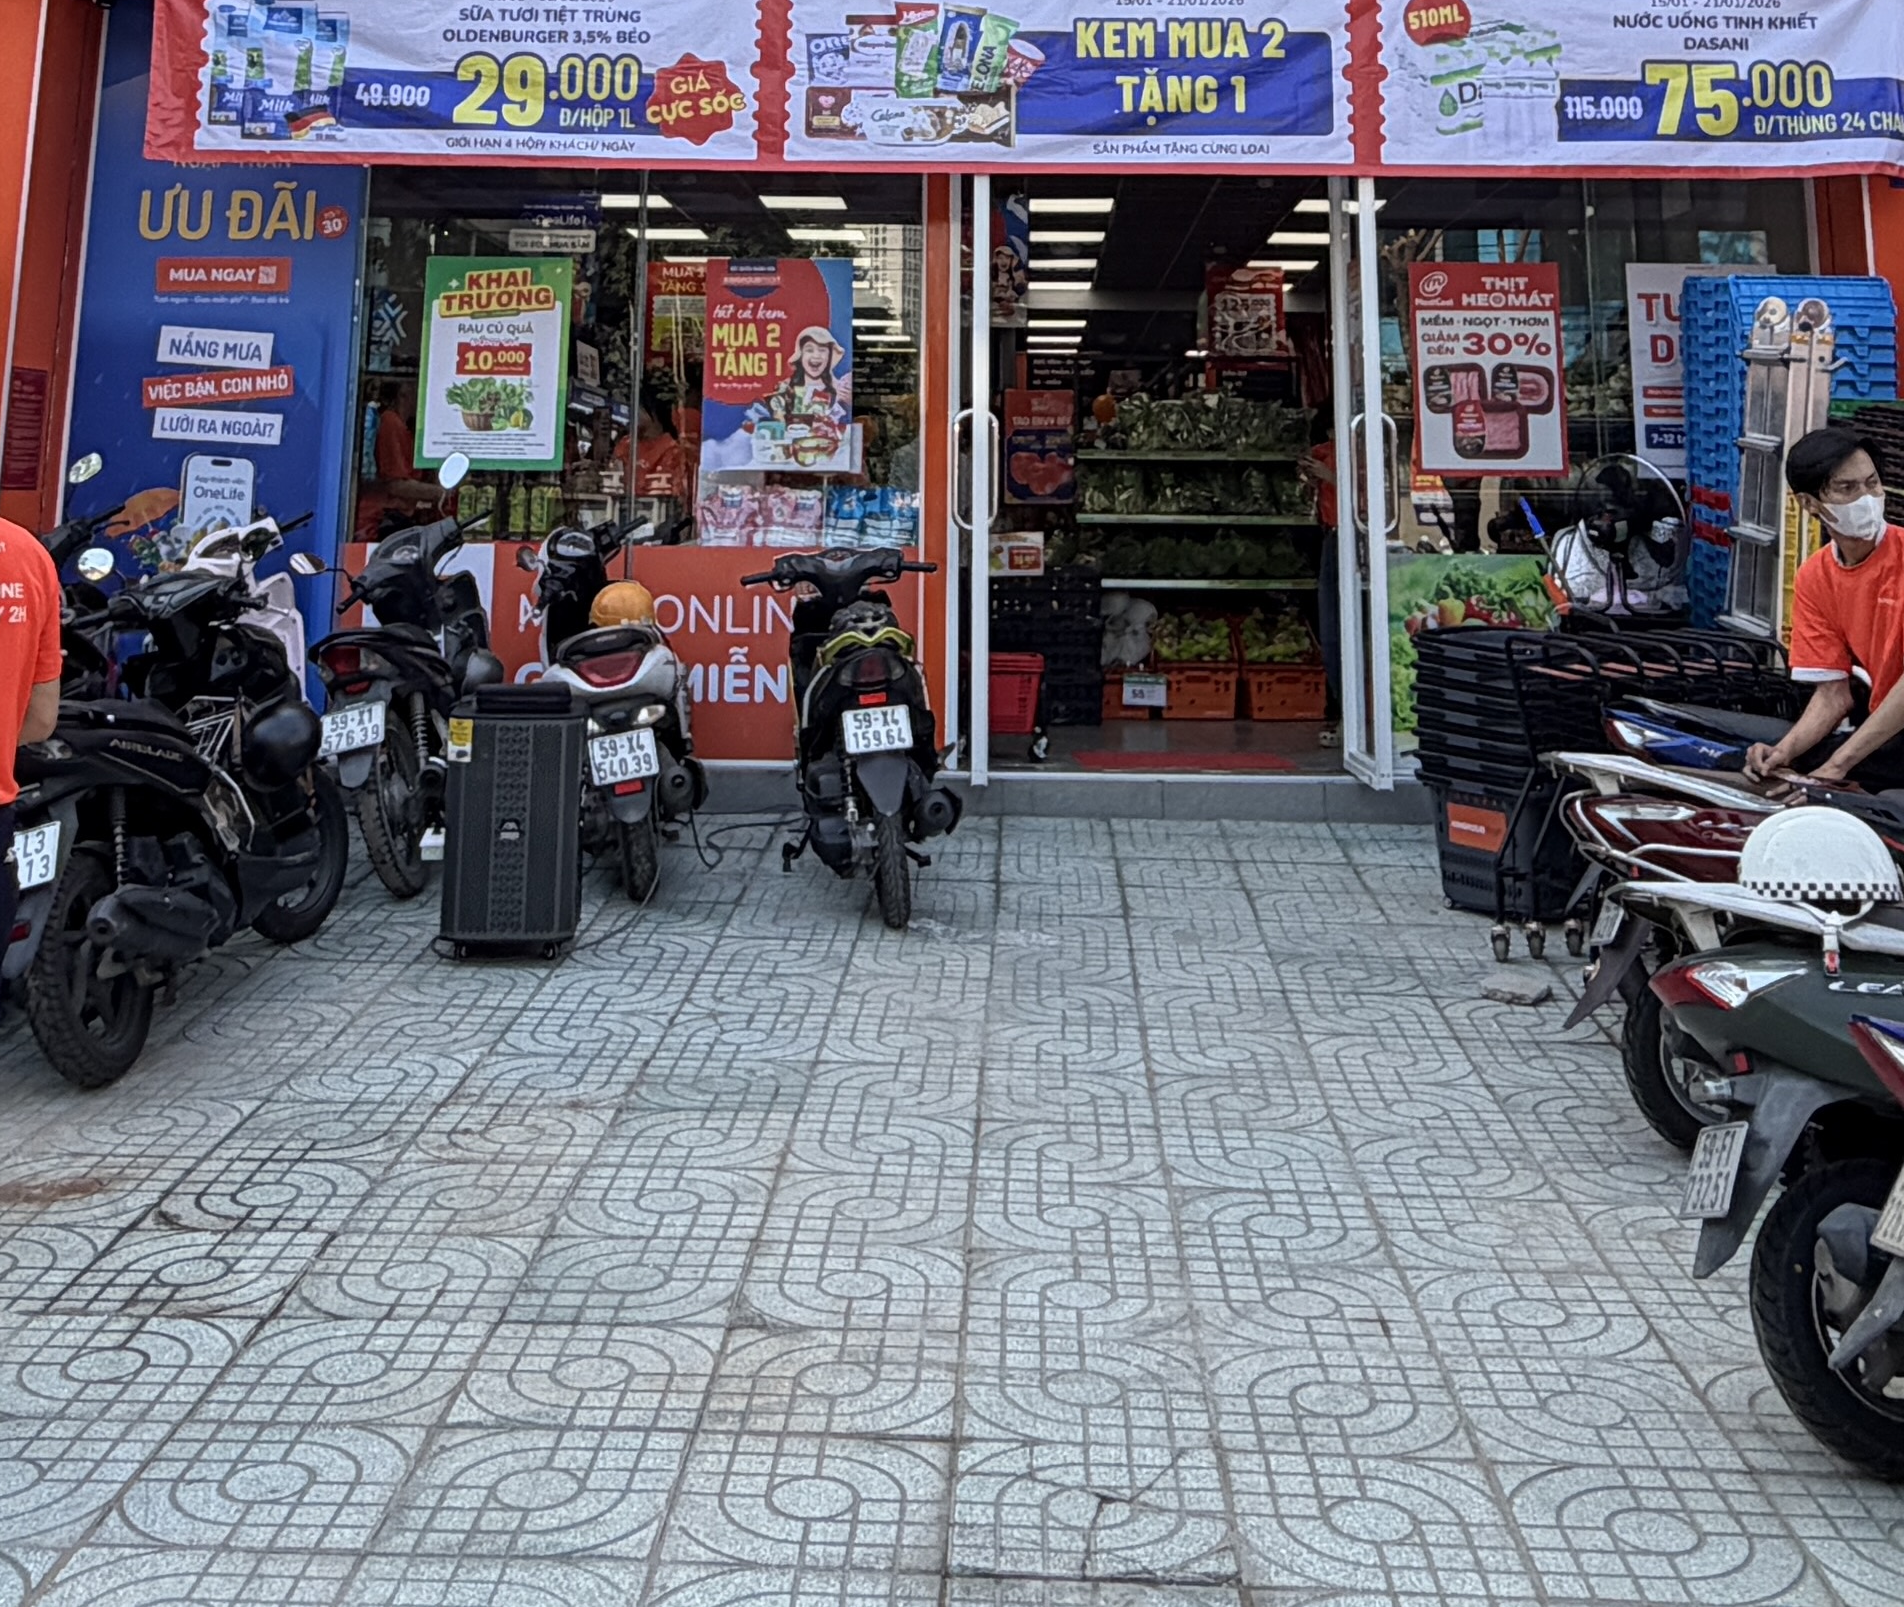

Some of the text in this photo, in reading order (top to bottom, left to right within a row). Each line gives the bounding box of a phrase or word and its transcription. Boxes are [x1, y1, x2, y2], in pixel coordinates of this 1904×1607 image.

[458, 5, 642, 26] SỮA TƯƠI TIỆT TRÙNG
[1407, 3, 1465, 31] 510ML
[1613, 10, 1818, 30] NƯỚC UỐNG TINH KHIẾT
[442, 28, 569, 45] OLDENBURGER
[572, 29, 612, 45] 3,5%
[1076, 20, 1286, 58] KEM MUA 2
[1684, 36, 1749, 51] DASANI
[670, 68, 711, 95] GIÁ
[354, 82, 431, 107] 49.900
[1115, 67, 1247, 127] TẶNG 1
[1564, 63, 1834, 136] 115.000 75.000
[558, 103, 636, 133] Đ/HỘP 1L
[645, 88, 747, 126] CỰC SỐC
[1753, 111, 1837, 135] Đ/THÙNG
[1842, 114, 1866, 132] 24
[138, 181, 317, 241] ƯU ĐÃI
[321, 218, 343, 235] 30
[169, 267, 257, 283] MUA NGAY
[467, 270, 530, 291] KHAI
[1480, 275, 1529, 293] THỊT
[442, 287, 552, 312] TRƯƠNG
[756, 301, 788, 320] kem
[1508, 290, 1555, 307] MÁT
[458, 320, 534, 336] RAU CỦ QUẢ
[1420, 314, 1550, 329] MỀM NGỌT THƠM
[168, 331, 262, 363] NẮNG MƯA
[711, 322, 782, 348] MUA 2
[1421, 331, 1552, 357] GIẢM 30%
[463, 350, 526, 371] 10.000
[1426, 343, 1456, 356] ĐẾN
[711, 347, 783, 381] TẶNG 1
[147, 368, 288, 402] VIỆC BẬN, CON NHỎ
[160, 414, 275, 438] LƯỜI RA NGOÀI?
[193, 486, 246, 501] OneLife
[8, 605, 28, 624] 2H
[652, 593, 795, 635] ONLIN
[329, 710, 374, 733] 59-X1
[852, 708, 900, 730] 59-X4
[598, 731, 646, 760] 59-X4
